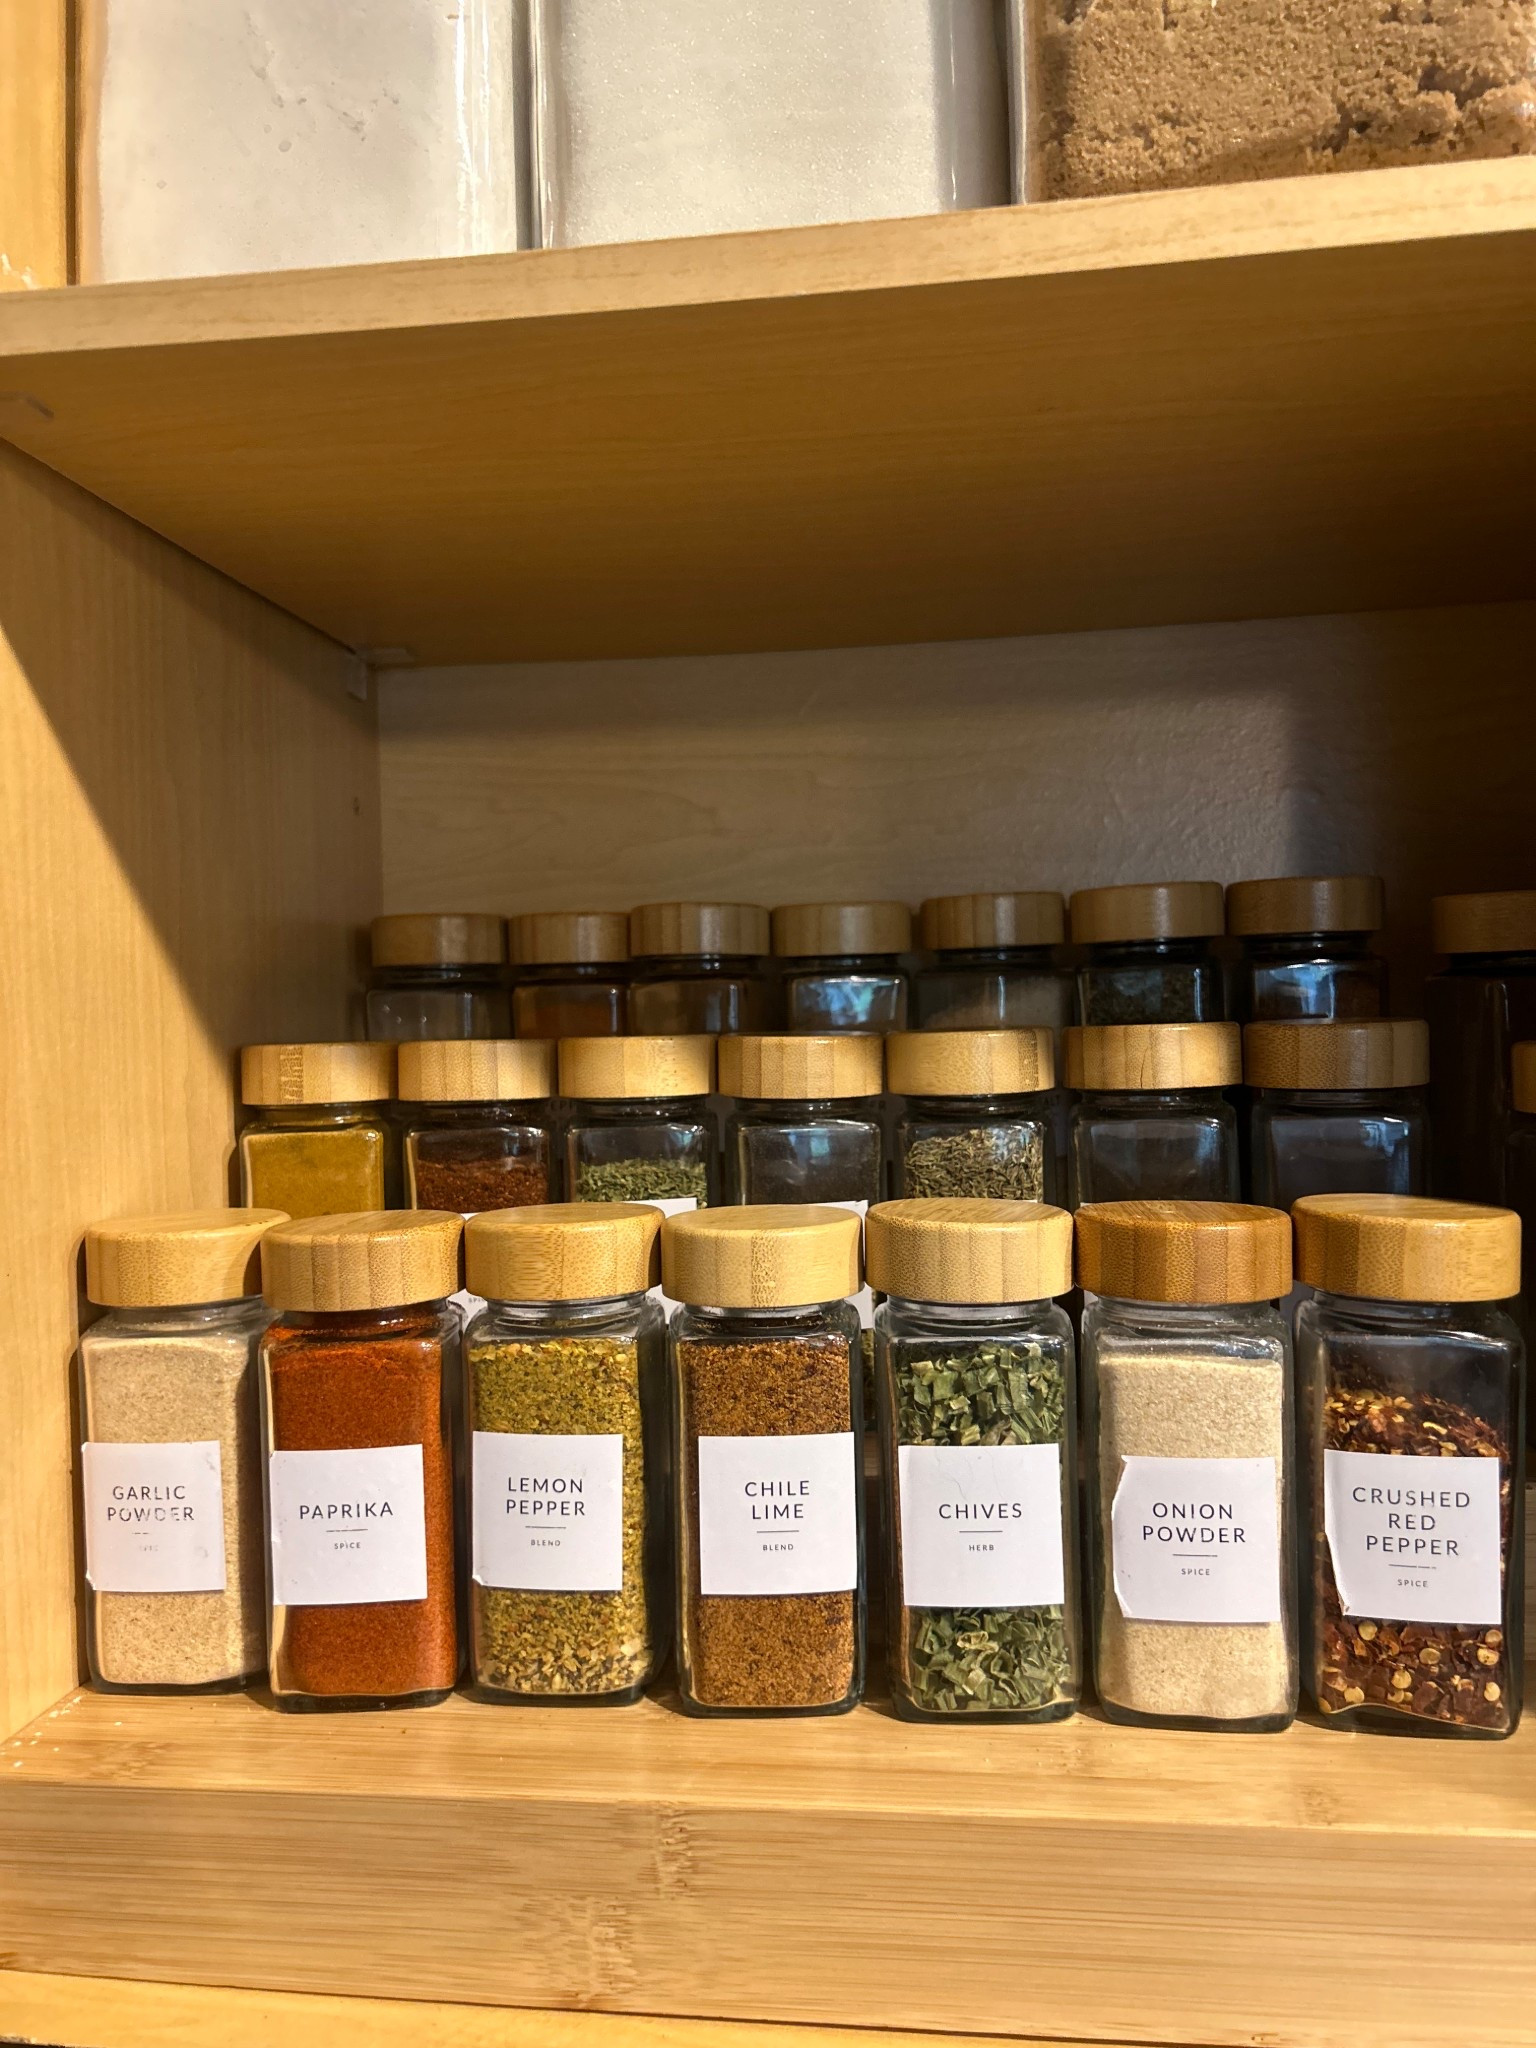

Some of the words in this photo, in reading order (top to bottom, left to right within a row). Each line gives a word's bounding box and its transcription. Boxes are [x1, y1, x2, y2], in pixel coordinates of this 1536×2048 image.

[112, 1485, 186, 1501] GARLIC
[508, 1476, 583, 1494] LEMON
[744, 1480, 810, 1497] CHILE
[1352, 1486, 1470, 1508] CRUSHED
[107, 1506, 195, 1522] POWDER
[299, 1501, 394, 1520] PAPRIKA
[506, 1498, 585, 1516] PEPPER
[752, 1503, 804, 1520] LIME
[938, 1502, 1022, 1520] CHIVES
[1152, 1502, 1233, 1520] ONION
[1388, 1512, 1436, 1531] RED
[1142, 1525, 1246, 1543] POWDER
[333, 1541, 361, 1550] SPICE
[530, 1539, 561, 1547] BLEND
[762, 1543, 794, 1552] BLEND
[968, 1544, 995, 1552] HERB
[1366, 1534, 1459, 1556] PEPPER
[1180, 1568, 1210, 1576] SPICE
[1397, 1578, 1428, 1588] SPICE
